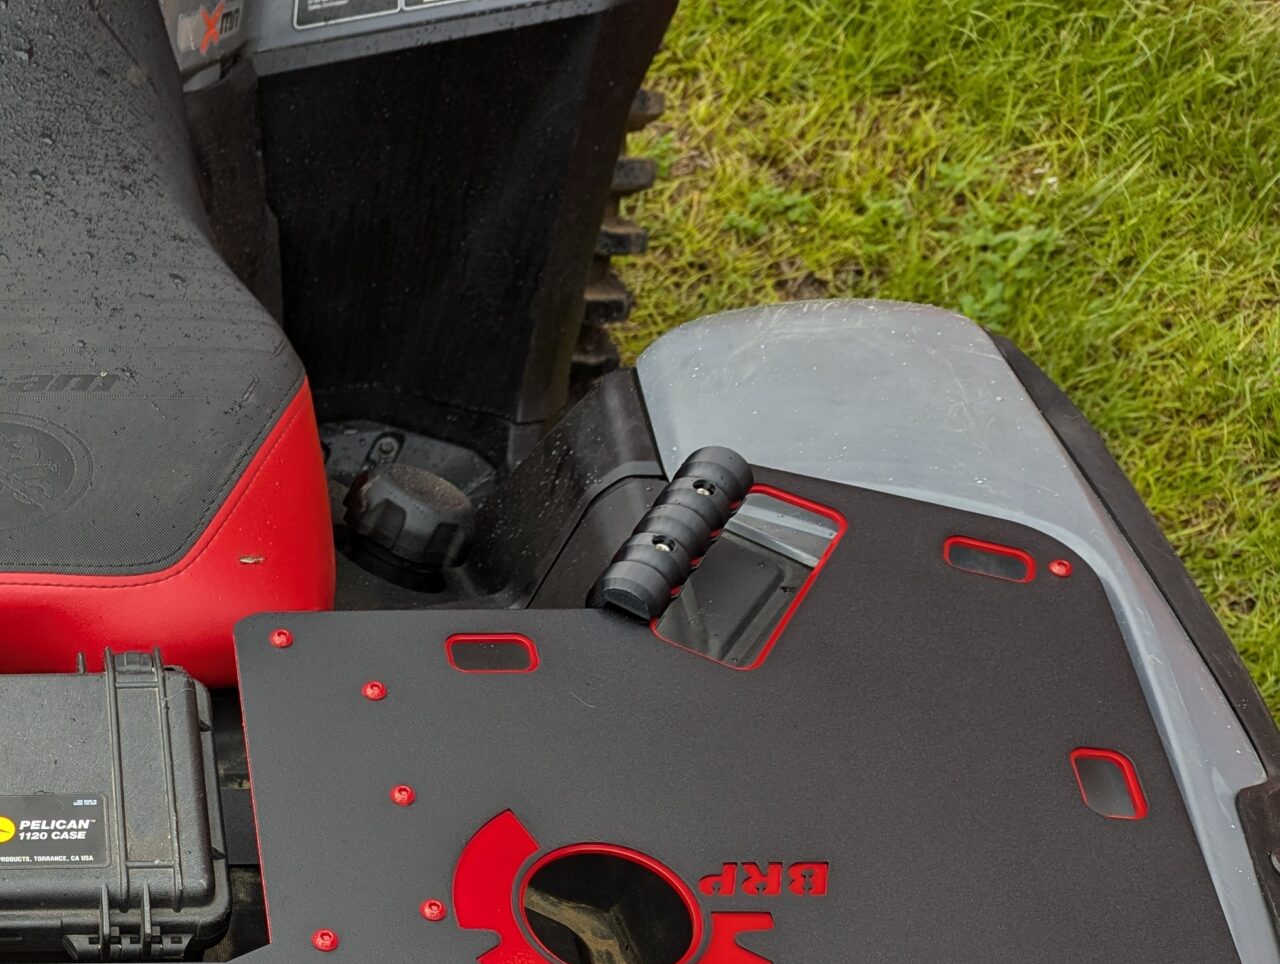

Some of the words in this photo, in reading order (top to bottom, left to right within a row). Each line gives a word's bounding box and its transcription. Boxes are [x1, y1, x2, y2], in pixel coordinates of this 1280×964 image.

[18, 831, 48, 841] 1120
[51, 830, 87, 840] CASE
[696, 860, 830, 897] BRP
